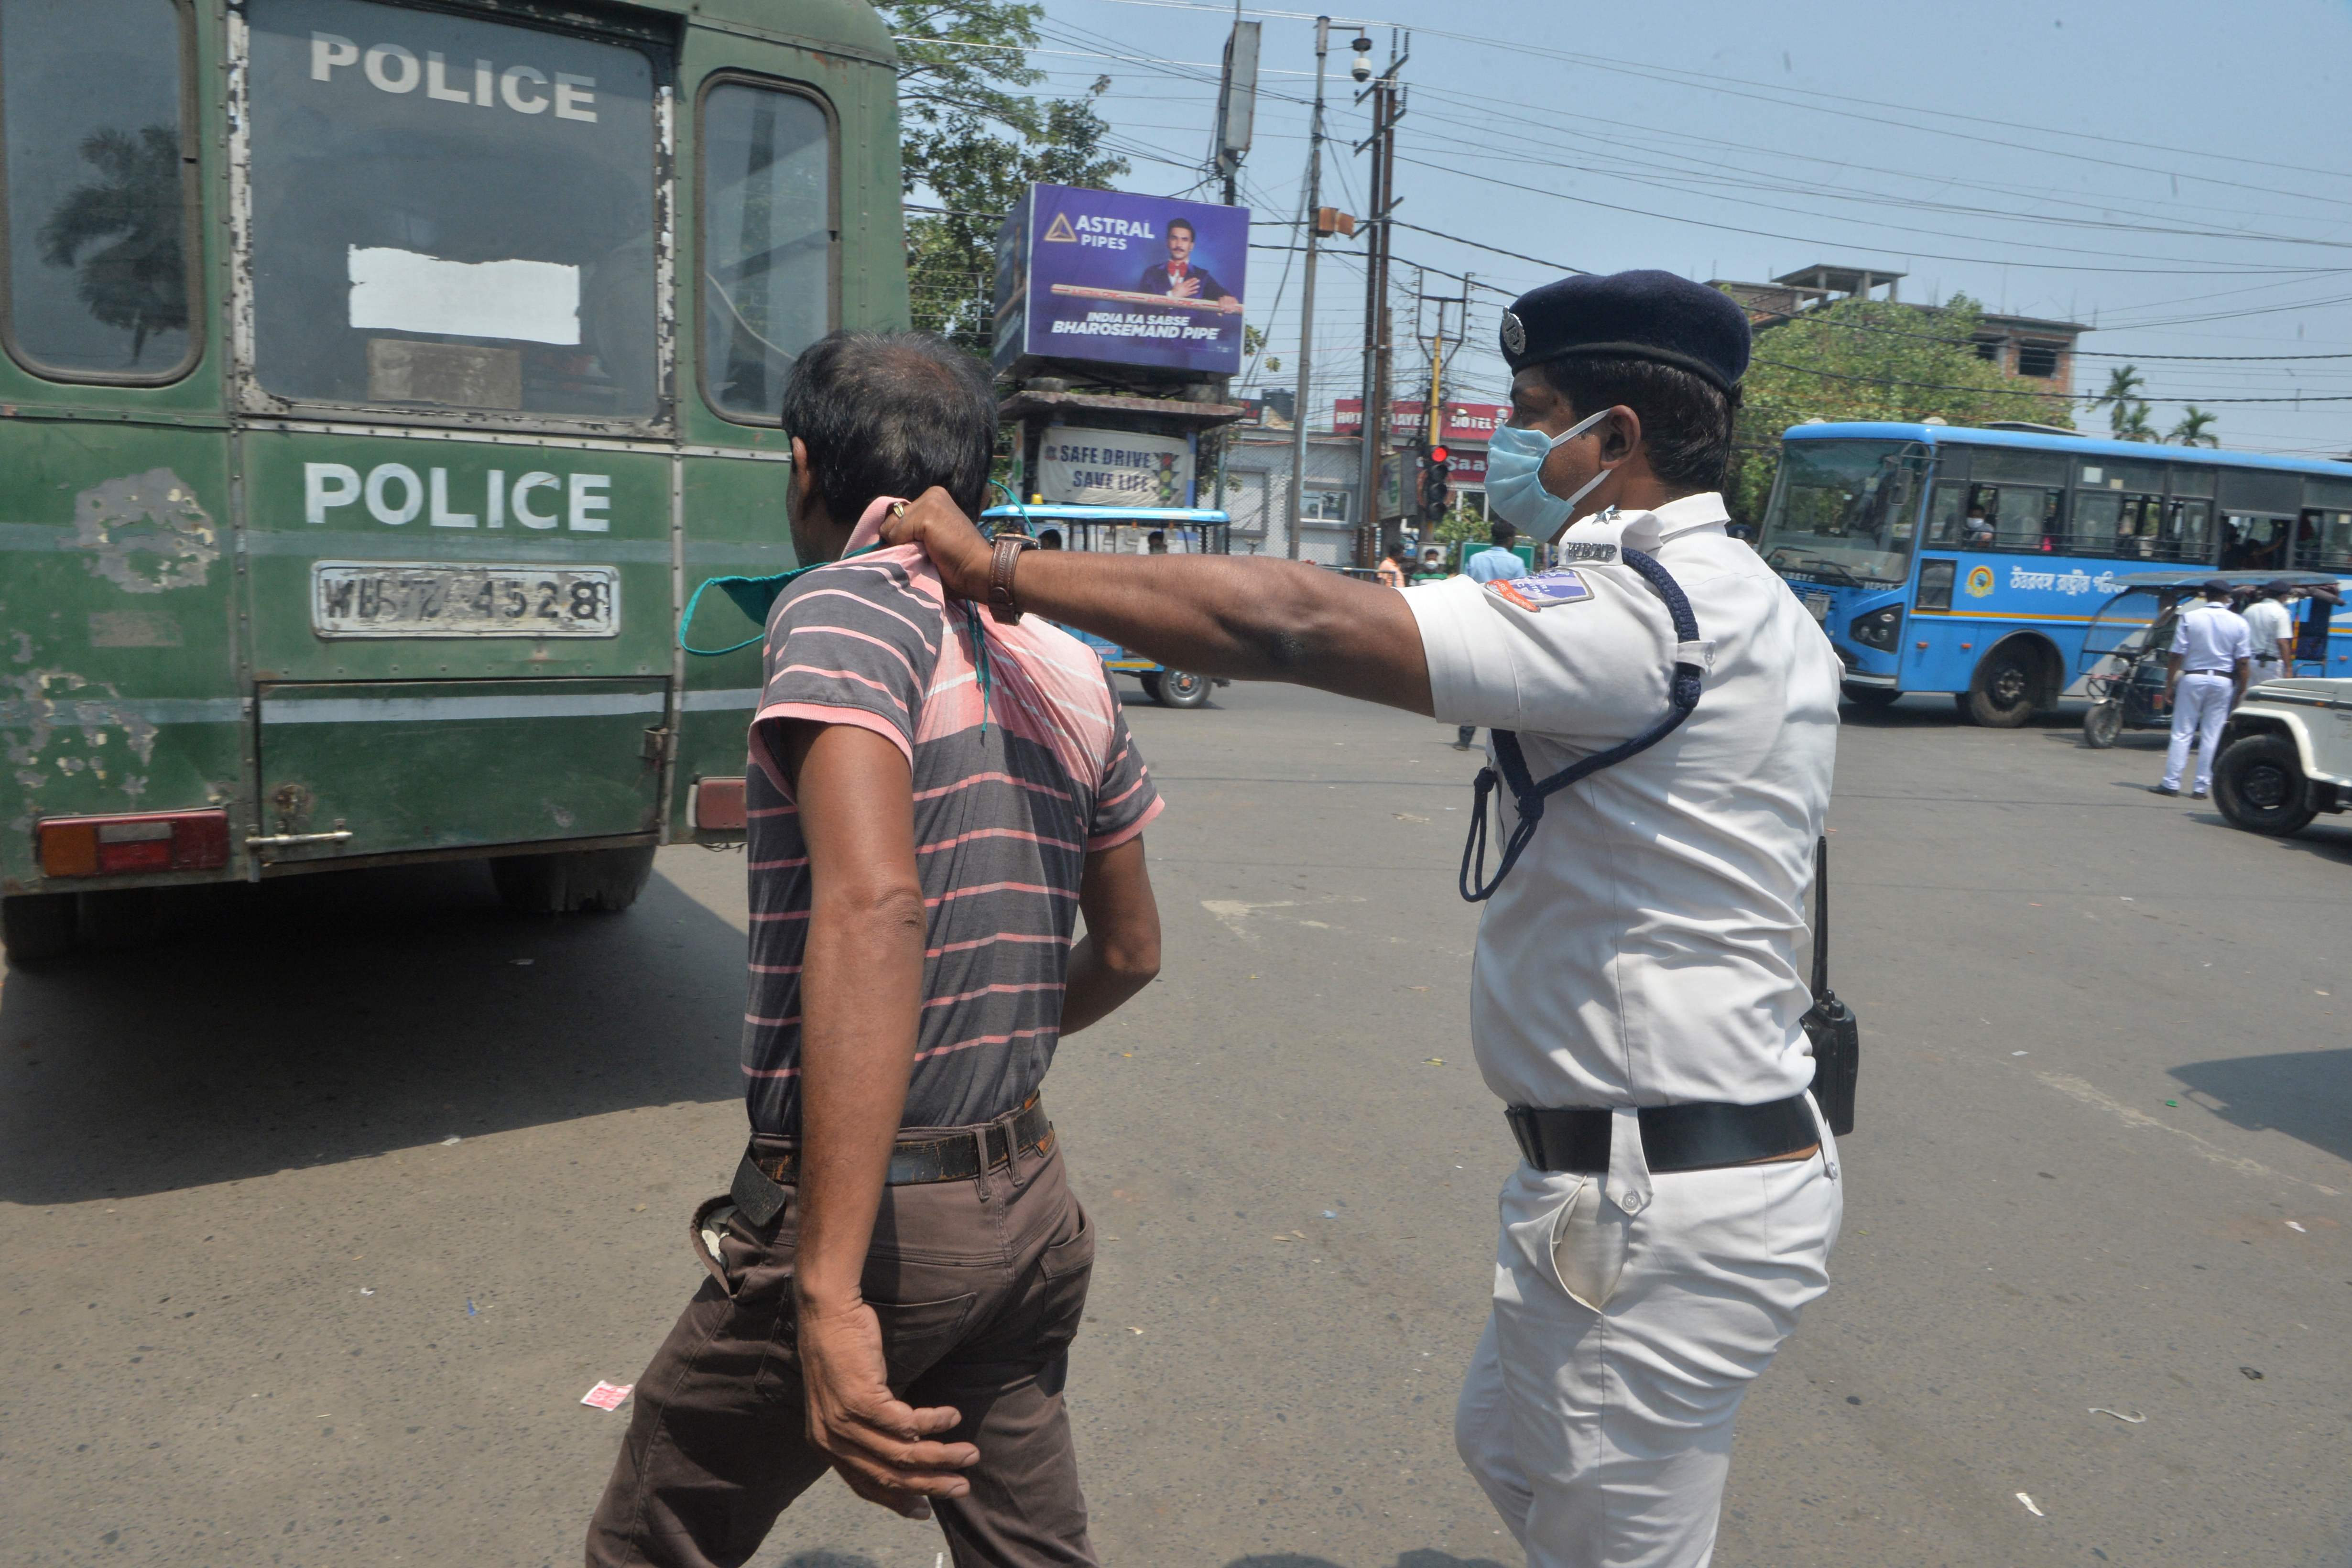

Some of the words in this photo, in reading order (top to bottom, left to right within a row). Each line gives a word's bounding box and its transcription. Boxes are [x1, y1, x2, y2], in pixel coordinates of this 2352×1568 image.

[311, 30, 598, 123] POLICE
[1075, 215, 1155, 239] ASTRAL
[1081, 234, 1127, 250] PIPES
[1087, 312, 1123, 323] INDIA
[1125, 314, 1145, 324] KA
[1146, 315, 1191, 326] SABSE
[1051, 321, 1180, 338] BHAROSEMAND
[1181, 327, 1221, 340] PIPE
[1060, 445, 1097, 464] SAFE
[1101, 448, 1151, 468] DRIVE
[1073, 470, 1114, 490] SAVE
[1119, 474, 1148, 492] LIFE
[304, 462, 611, 532] POLICE
[1567, 542, 1617, 559] WBAP
